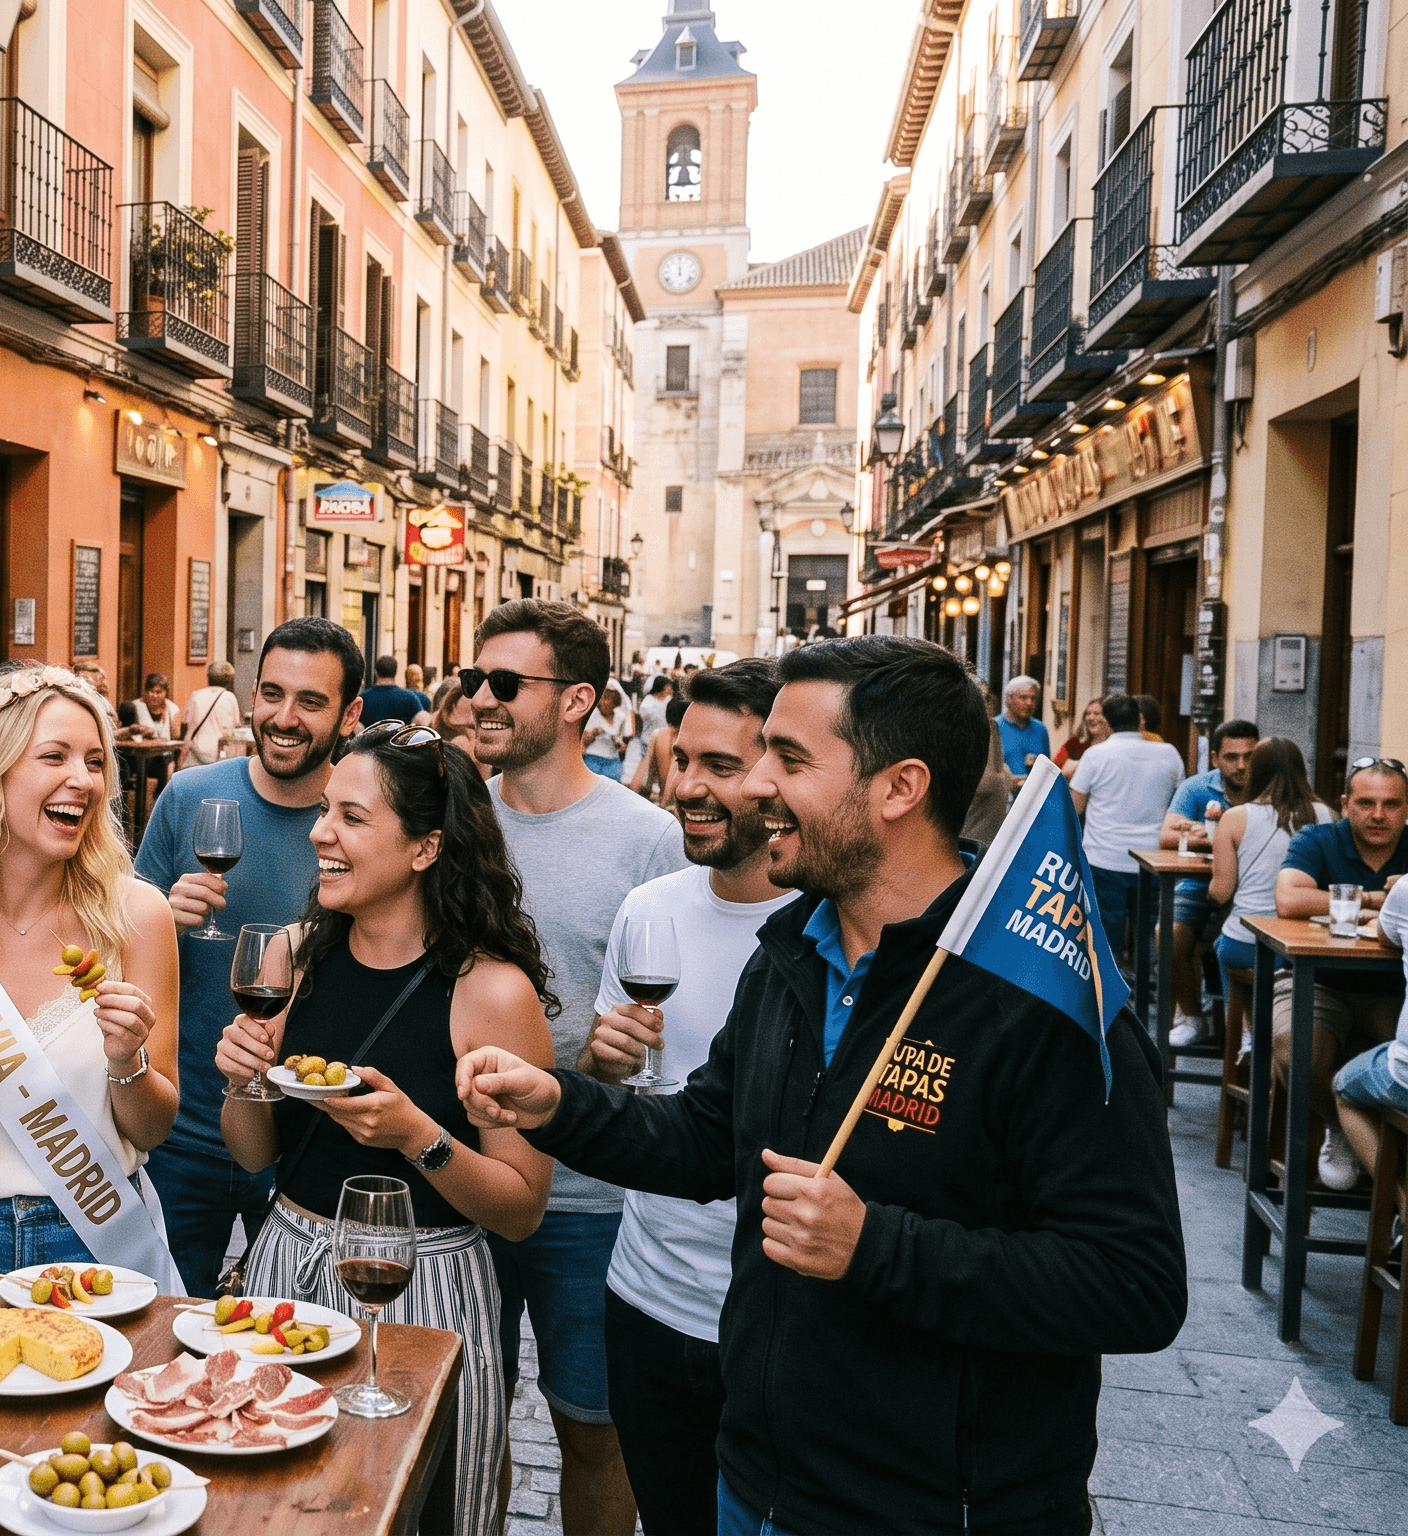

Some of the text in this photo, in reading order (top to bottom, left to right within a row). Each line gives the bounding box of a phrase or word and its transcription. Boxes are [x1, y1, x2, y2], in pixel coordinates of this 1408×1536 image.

[1005, 908, 1091, 981] MADRID
[878, 1063, 948, 1103] TAPAS
[927, 1053, 956, 1078] DE
[867, 1088, 941, 1125] MADRID
[19, 1099, 121, 1225] MADRID
